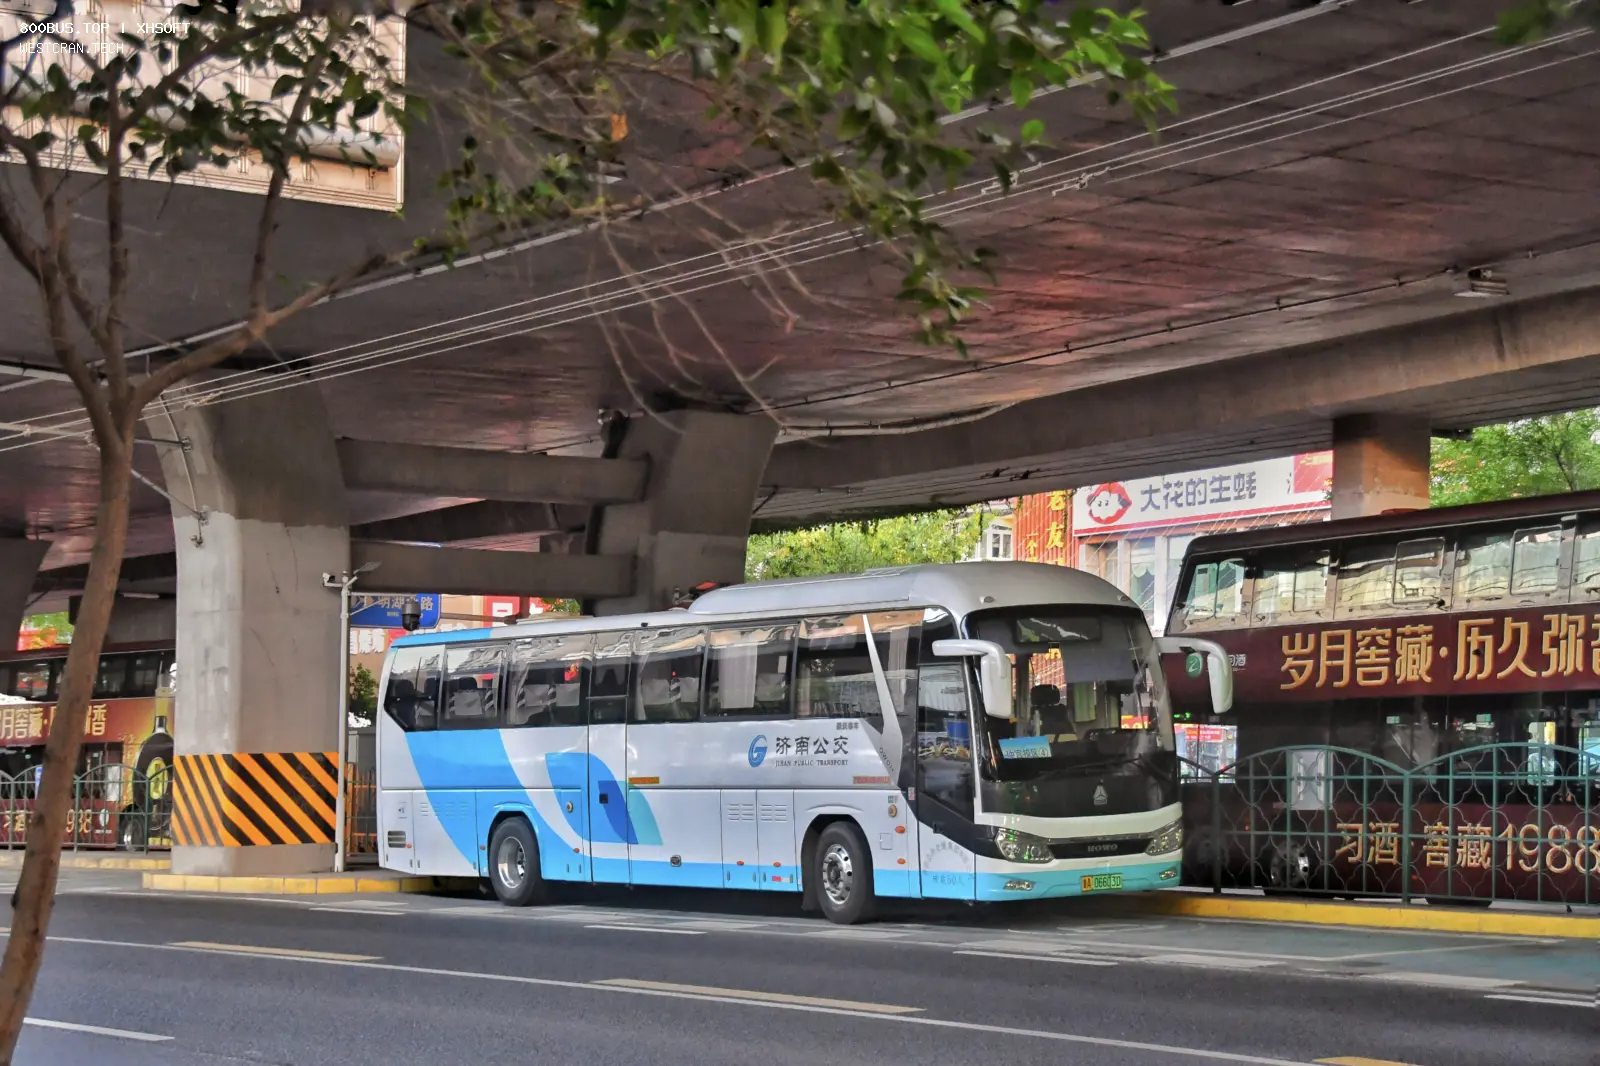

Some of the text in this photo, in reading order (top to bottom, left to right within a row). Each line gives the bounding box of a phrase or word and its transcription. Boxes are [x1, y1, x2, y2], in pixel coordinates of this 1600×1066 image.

[1140, 471, 1257, 513] 大花的生蚝
[1280, 613, 1600, 690] 岁月窖藏·历久弥
[776, 735, 849, 756] 济南公交
[794, 759, 814, 767] PUBLIC
[817, 759, 849, 767] TRANSPORT
[1087, 843, 1119, 852] HOWO
